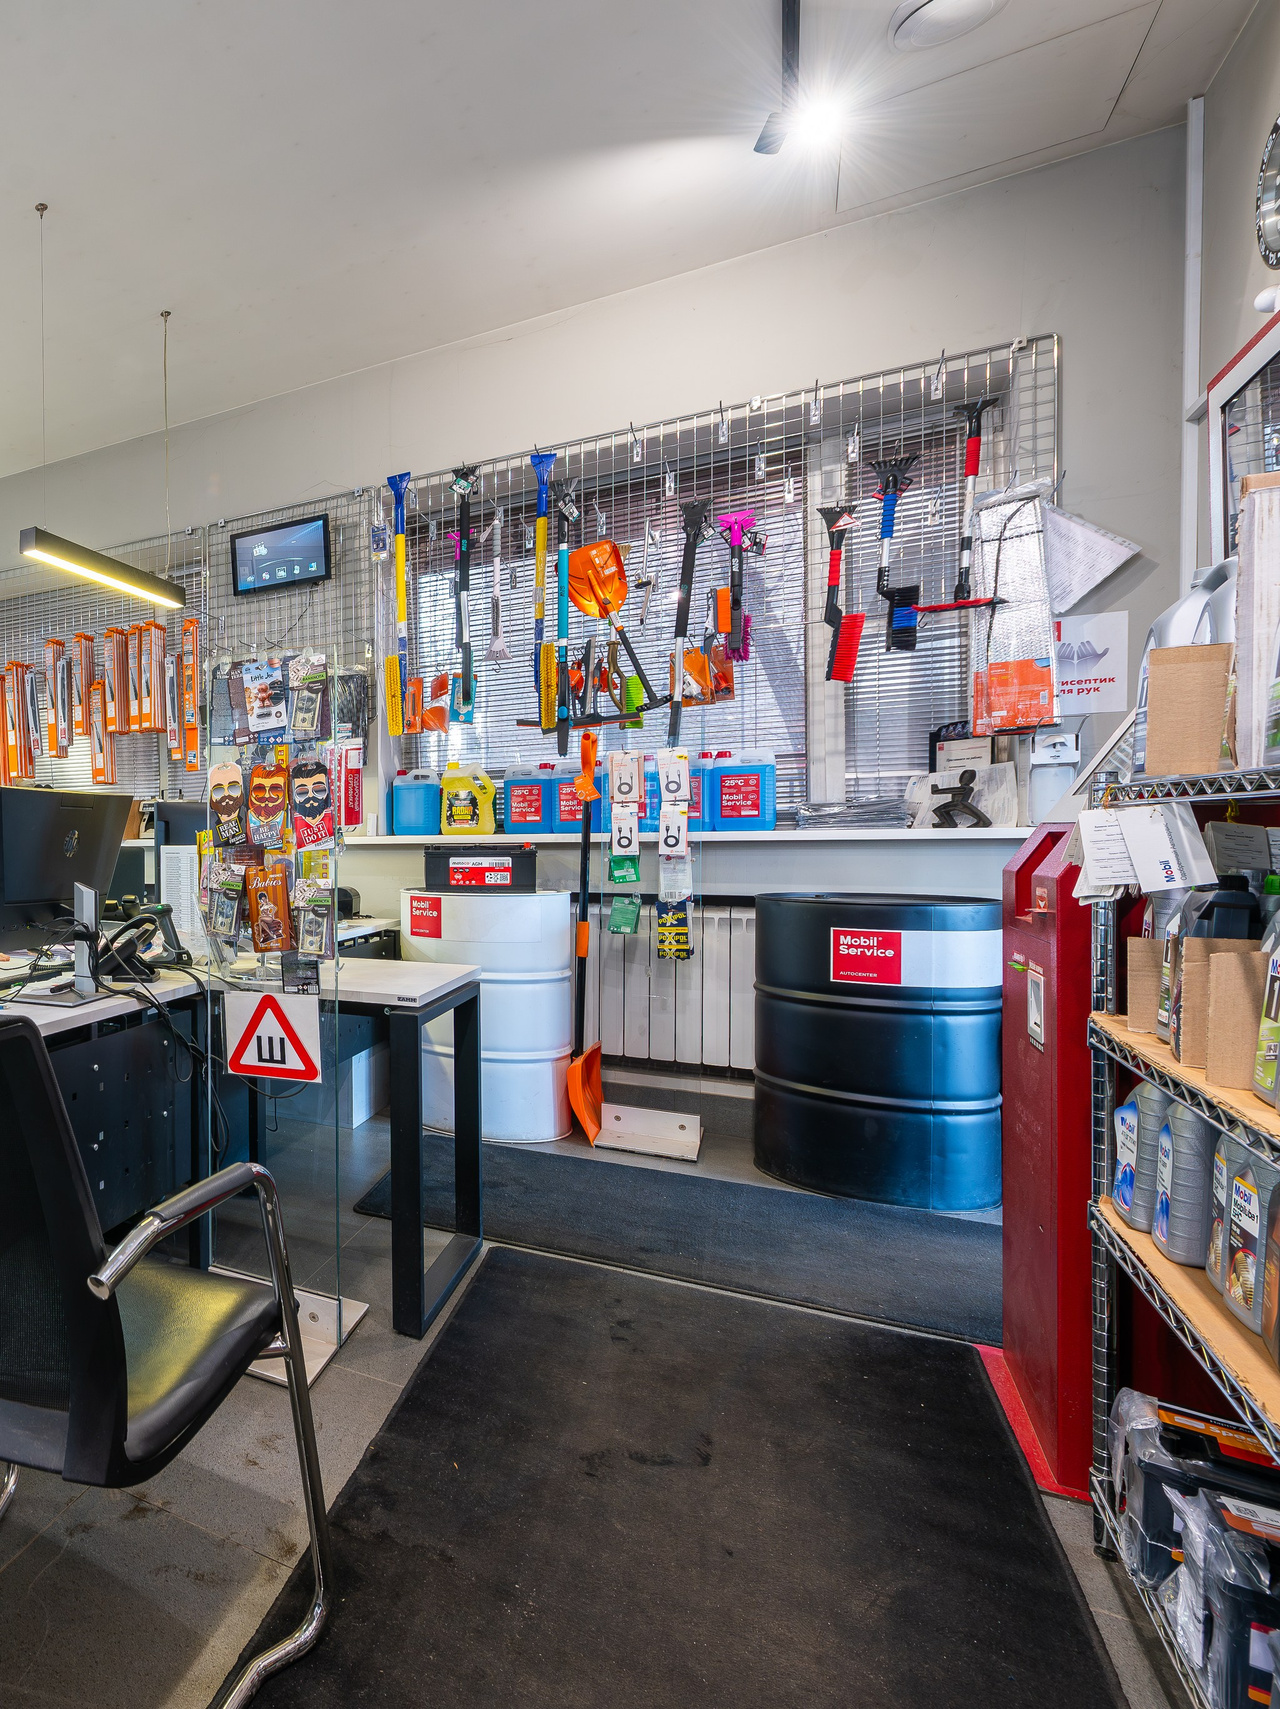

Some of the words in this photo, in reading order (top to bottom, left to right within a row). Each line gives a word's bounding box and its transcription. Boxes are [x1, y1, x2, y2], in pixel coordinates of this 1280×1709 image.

[250, 674, 264, 682] Little
[265, 672, 274, 680] Joe
[1060, 676, 1116, 686] исептик
[1077, 687, 1101, 695] рук
[452, 806, 473, 815] RADAR
[219, 820, 238, 831] REAL
[303, 823, 324, 837] JUST
[221, 825, 240, 839] MAN
[254, 830, 277, 841] HAPPY
[305, 834, 317, 843] DO
[317, 830, 327, 839] IT
[229, 833, 246, 844] FRESHCO
[263, 839, 283, 847] FRESHCO
[314, 837, 334, 847] FRESHCO
[1159, 859, 1177, 883] Mobil
[249, 876, 282, 889] Babies
[412, 900, 430, 909] Mobil
[412, 907, 438, 917] Service
[658, 912, 687, 927] POXIPOL
[658, 932, 688, 945] POXIPOL
[839, 935, 878, 947] Mobil
[659, 948, 688, 960] POXIPOL
[839, 945, 895, 958] Service
[256, 1035, 287, 1065] Ш
[1120, 1116, 1136, 1135] Mobil
[1234, 1183, 1252, 1206] Mobil
[1233, 1197, 1255, 1221] Mobilube
[1232, 1209, 1242, 1223] SHC
